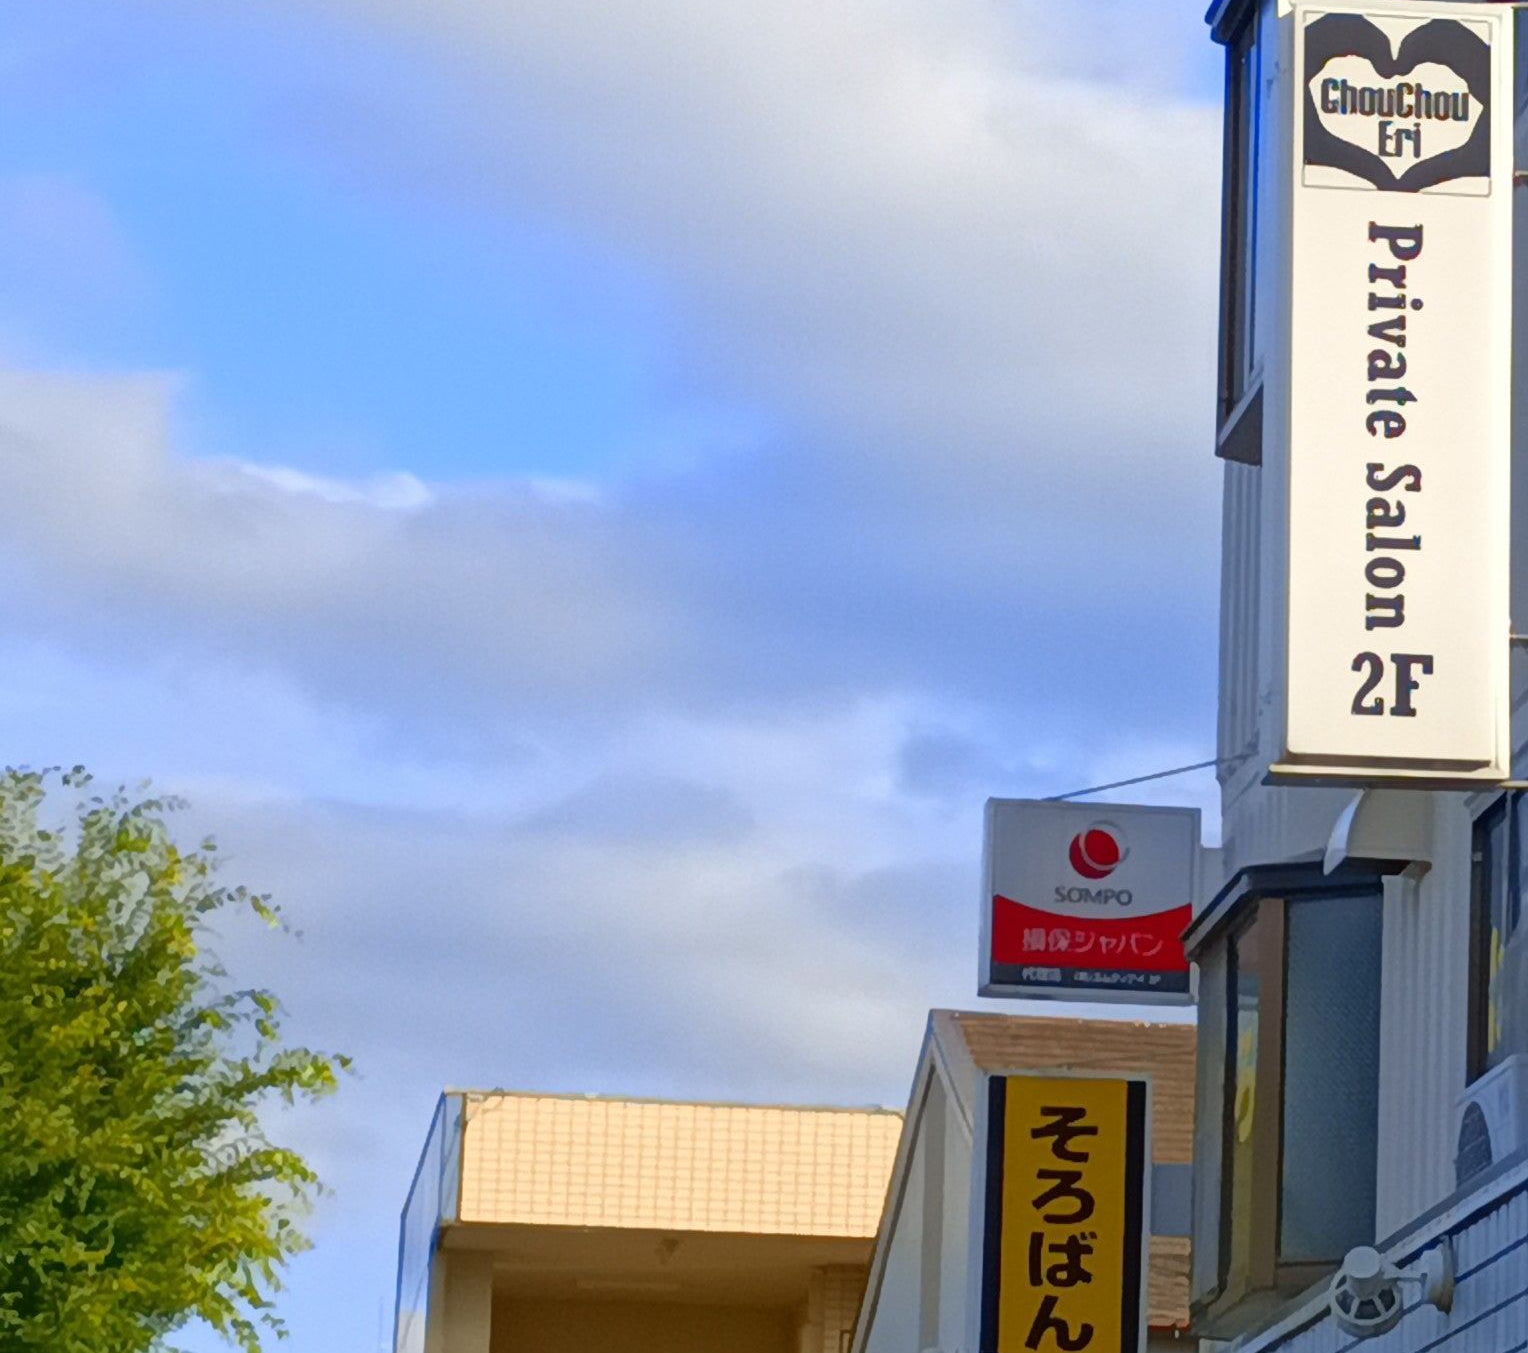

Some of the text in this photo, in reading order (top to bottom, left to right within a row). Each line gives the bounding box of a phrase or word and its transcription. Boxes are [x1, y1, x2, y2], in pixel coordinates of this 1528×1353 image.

[1320, 78, 1470, 122] ChouChou
[1378, 120, 1422, 159] Eri
[1365, 221, 1424, 632] Private Salon
[1351, 651, 1434, 717] 2F
[1054, 886, 1133, 907] SOMPO
[1024, 1106, 1098, 1352] そろばん
